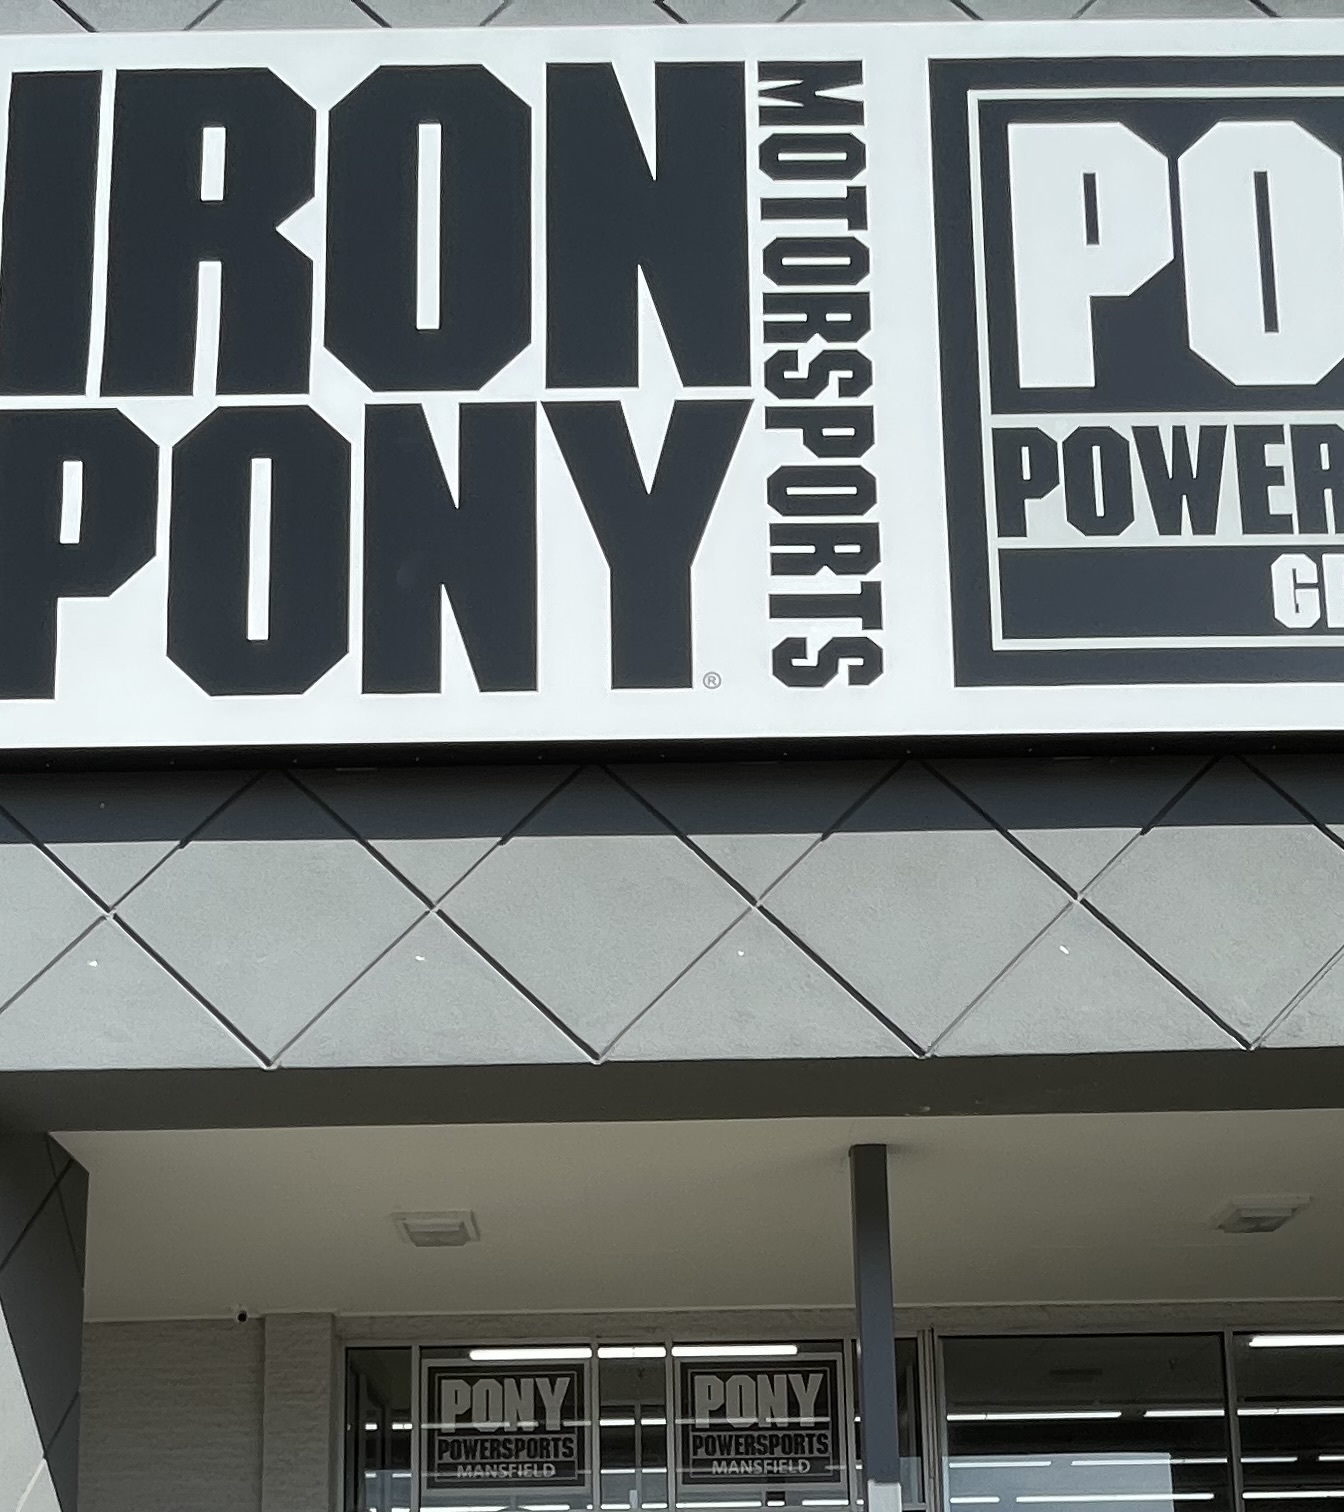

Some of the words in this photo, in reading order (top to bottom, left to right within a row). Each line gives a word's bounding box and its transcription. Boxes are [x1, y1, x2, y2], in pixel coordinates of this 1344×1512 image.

[756, 59, 884, 689] MOTORSPORTS
[439, 1376, 570, 1433] PONY
[694, 1373, 824, 1429] PONY
[437, 1435, 575, 1460] POWERSPORTS
[692, 1432, 829, 1458] POWERSPORTS
[457, 1463, 555, 1479] MANSFIELD
[712, 1459, 811, 1476] MANSFIELD
